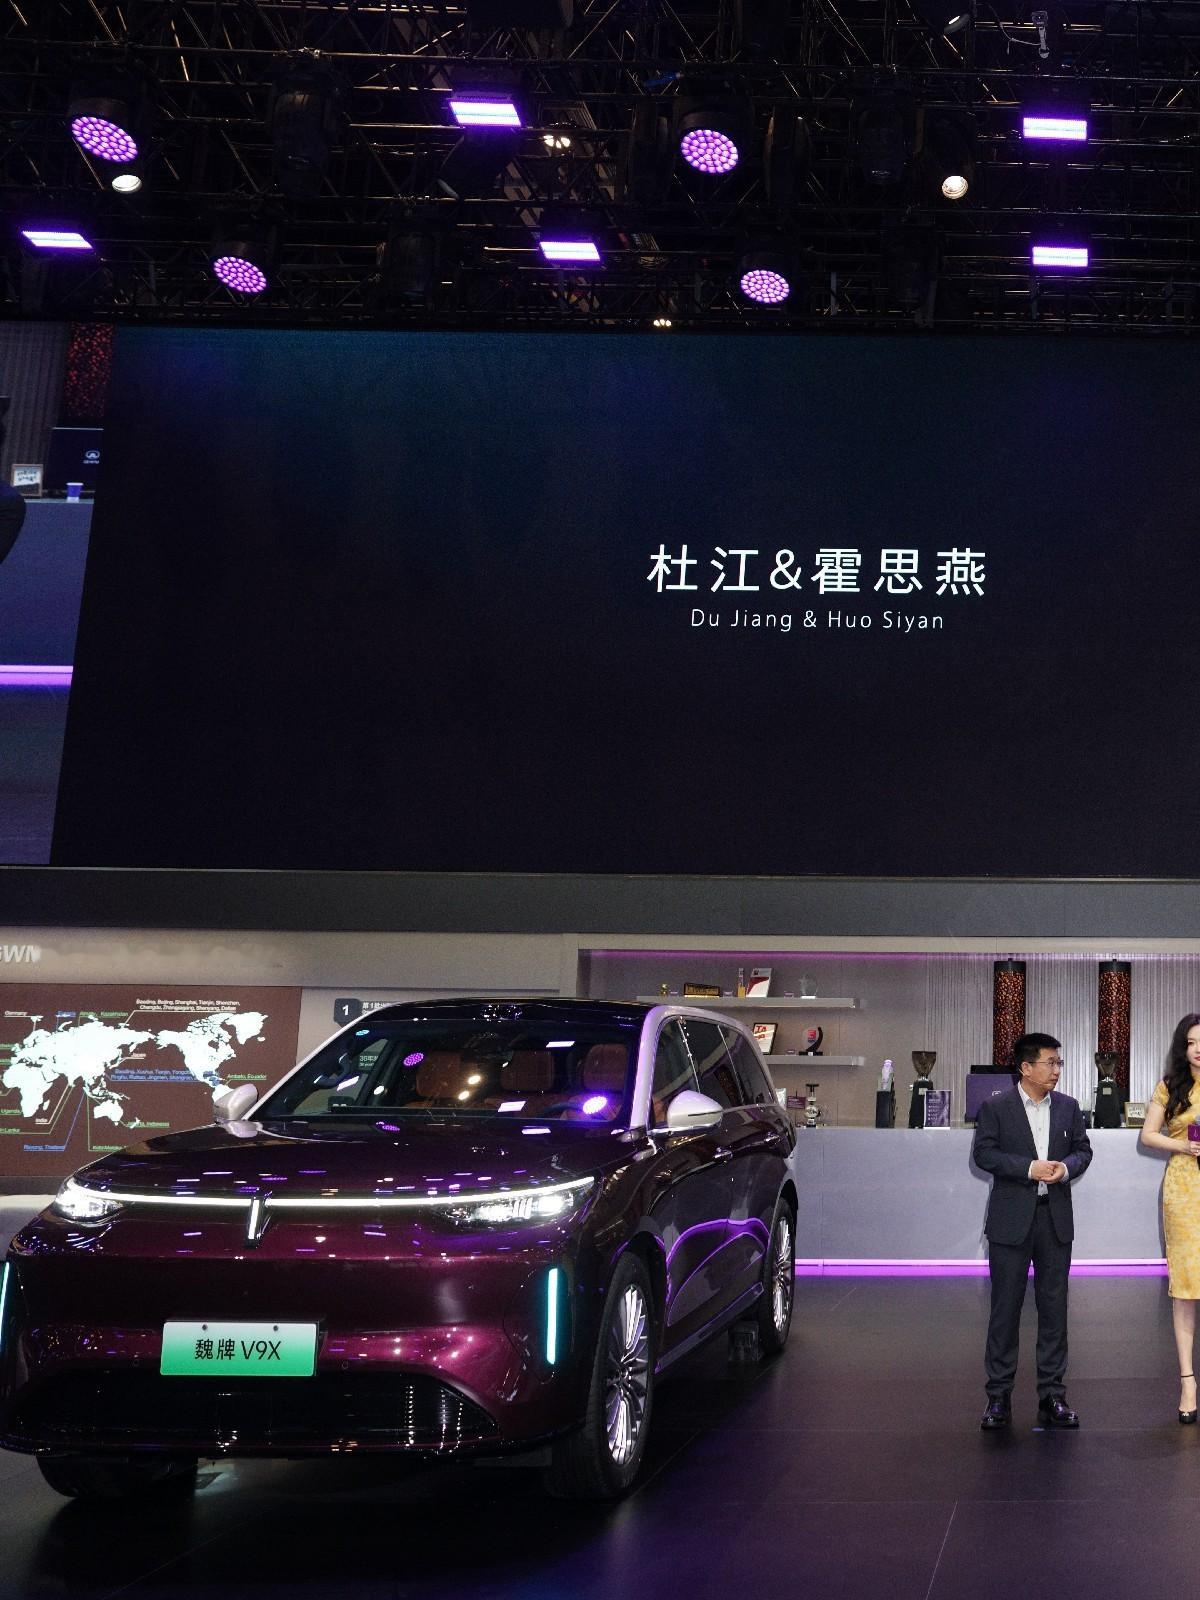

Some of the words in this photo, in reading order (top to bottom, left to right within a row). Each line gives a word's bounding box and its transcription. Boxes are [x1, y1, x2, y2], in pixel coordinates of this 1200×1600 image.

[647, 544, 986, 596] 杜江&霍思燕
[691, 609, 720, 627] Du
[731, 609, 792, 632] Jiang
[804, 610, 817, 628] &
[828, 611, 872, 629] Huo
[883, 611, 943, 633] Siyan
[342, 1005, 349, 1016] 1
[195, 1339, 236, 1361] 魏牌
[241, 1340, 282, 1361] V9X
